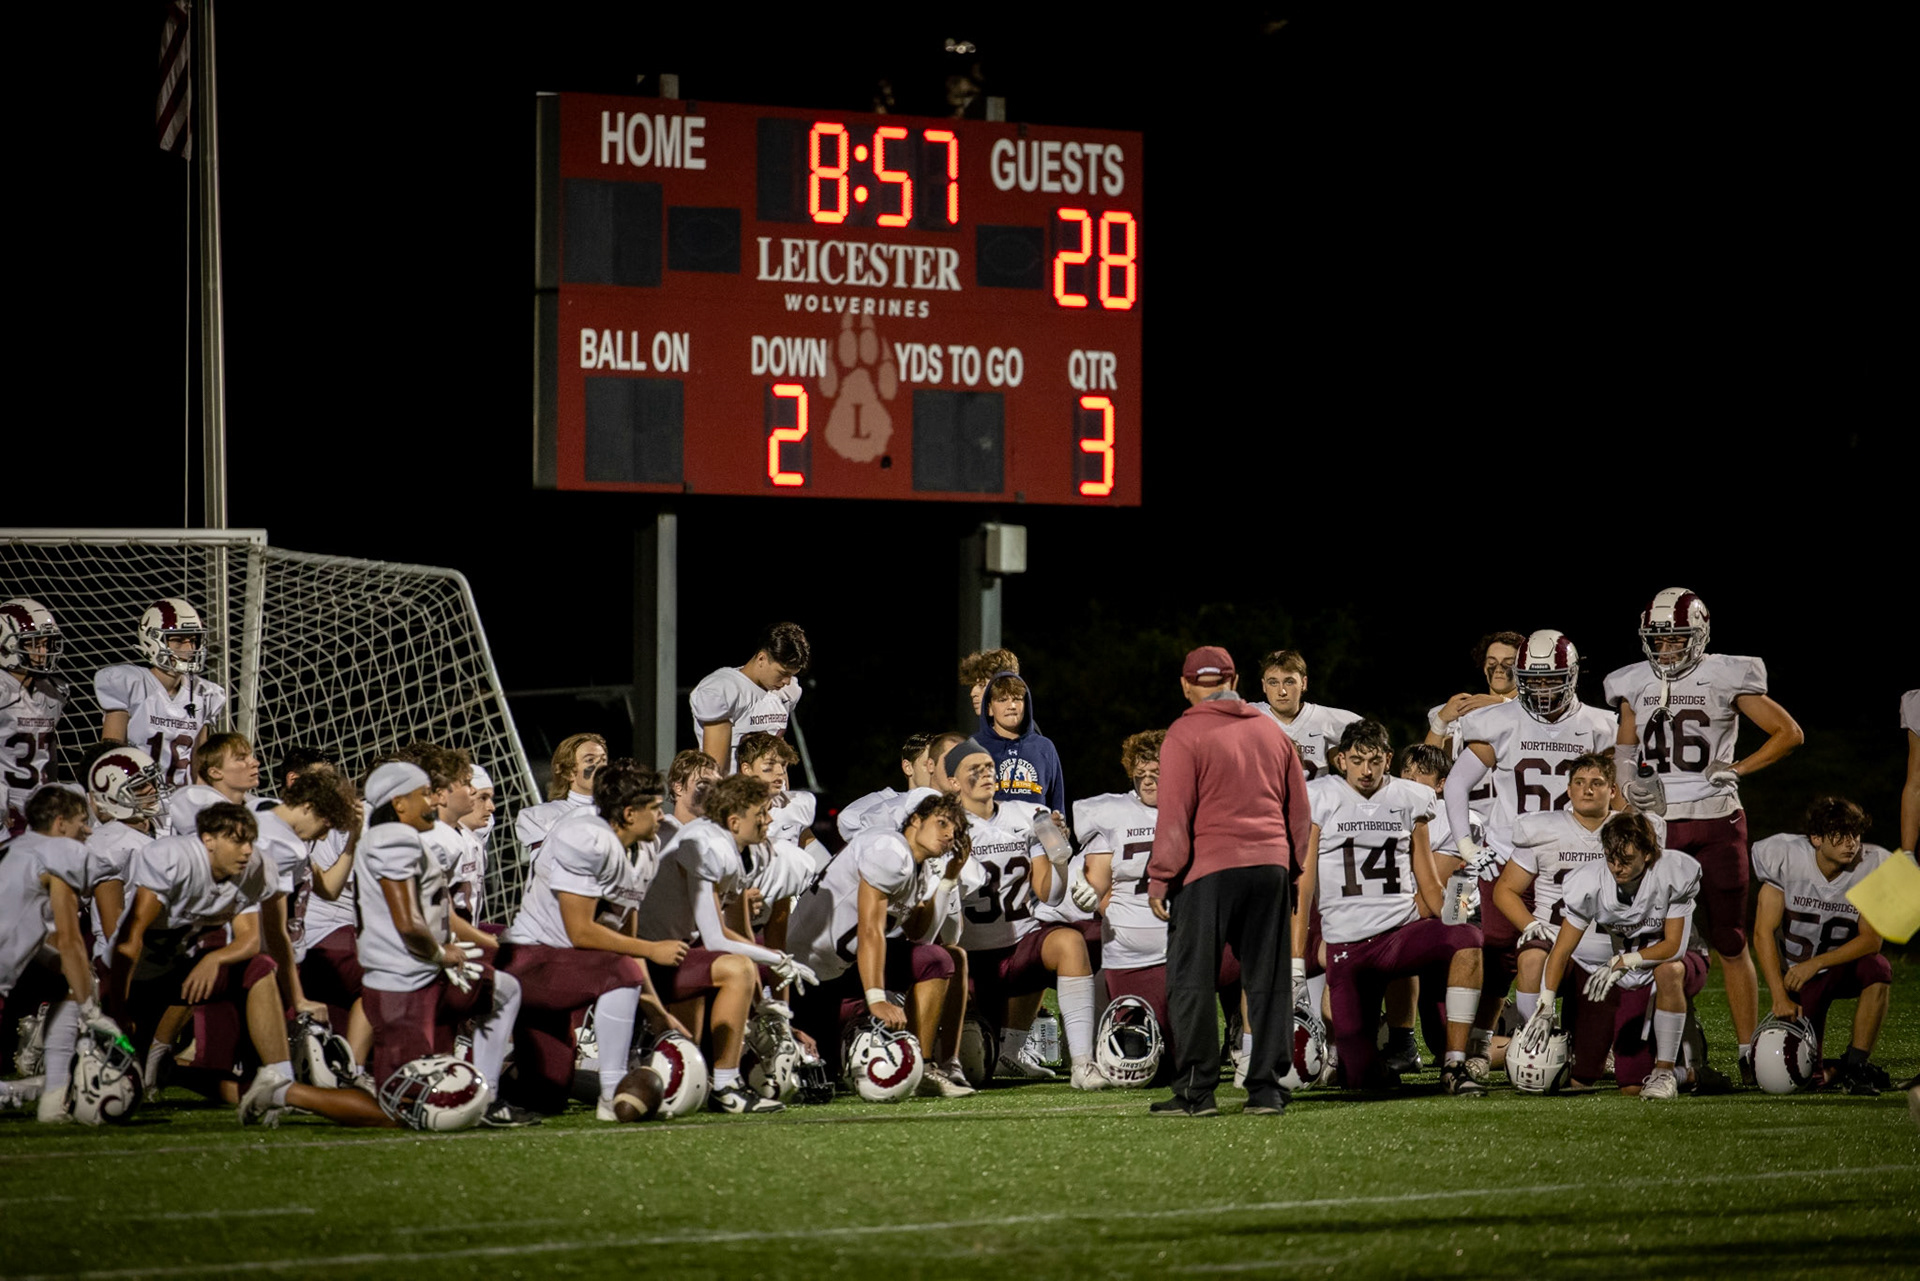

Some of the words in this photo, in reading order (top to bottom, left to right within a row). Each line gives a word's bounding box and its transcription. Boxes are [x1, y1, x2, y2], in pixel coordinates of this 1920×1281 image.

[601, 110, 706, 170] HOME
[809, 121, 959, 227] 8:57
[990, 138, 1125, 197] GUESTS
[756, 237, 962, 291] LEICESTER
[1053, 207, 1137, 310] 28
[784, 294, 930, 318] WOLVERINES
[580, 328, 647, 371] BALL
[652, 331, 690, 373] ON
[751, 335, 827, 377] DOWN
[895, 342, 943, 384] YDS
[948, 345, 981, 386] TO
[986, 347, 1024, 387] GO
[1068, 349, 1118, 391] QTR
[768, 383, 808, 486] 2
[851, 403, 871, 439] L
[1079, 395, 1115, 497] 3
[1520, 741, 1584, 755] NORTHBRIDGE
[1644, 709, 1711, 773] 46
[970, 842, 1027, 857] NORTHBRIDGE
[1337, 821, 1403, 833] NORTHBRIDGE
[964, 855, 1032, 924] 32
[1341, 837, 1401, 898] 14
[1792, 895, 1860, 915] NORTHBRIDGE
